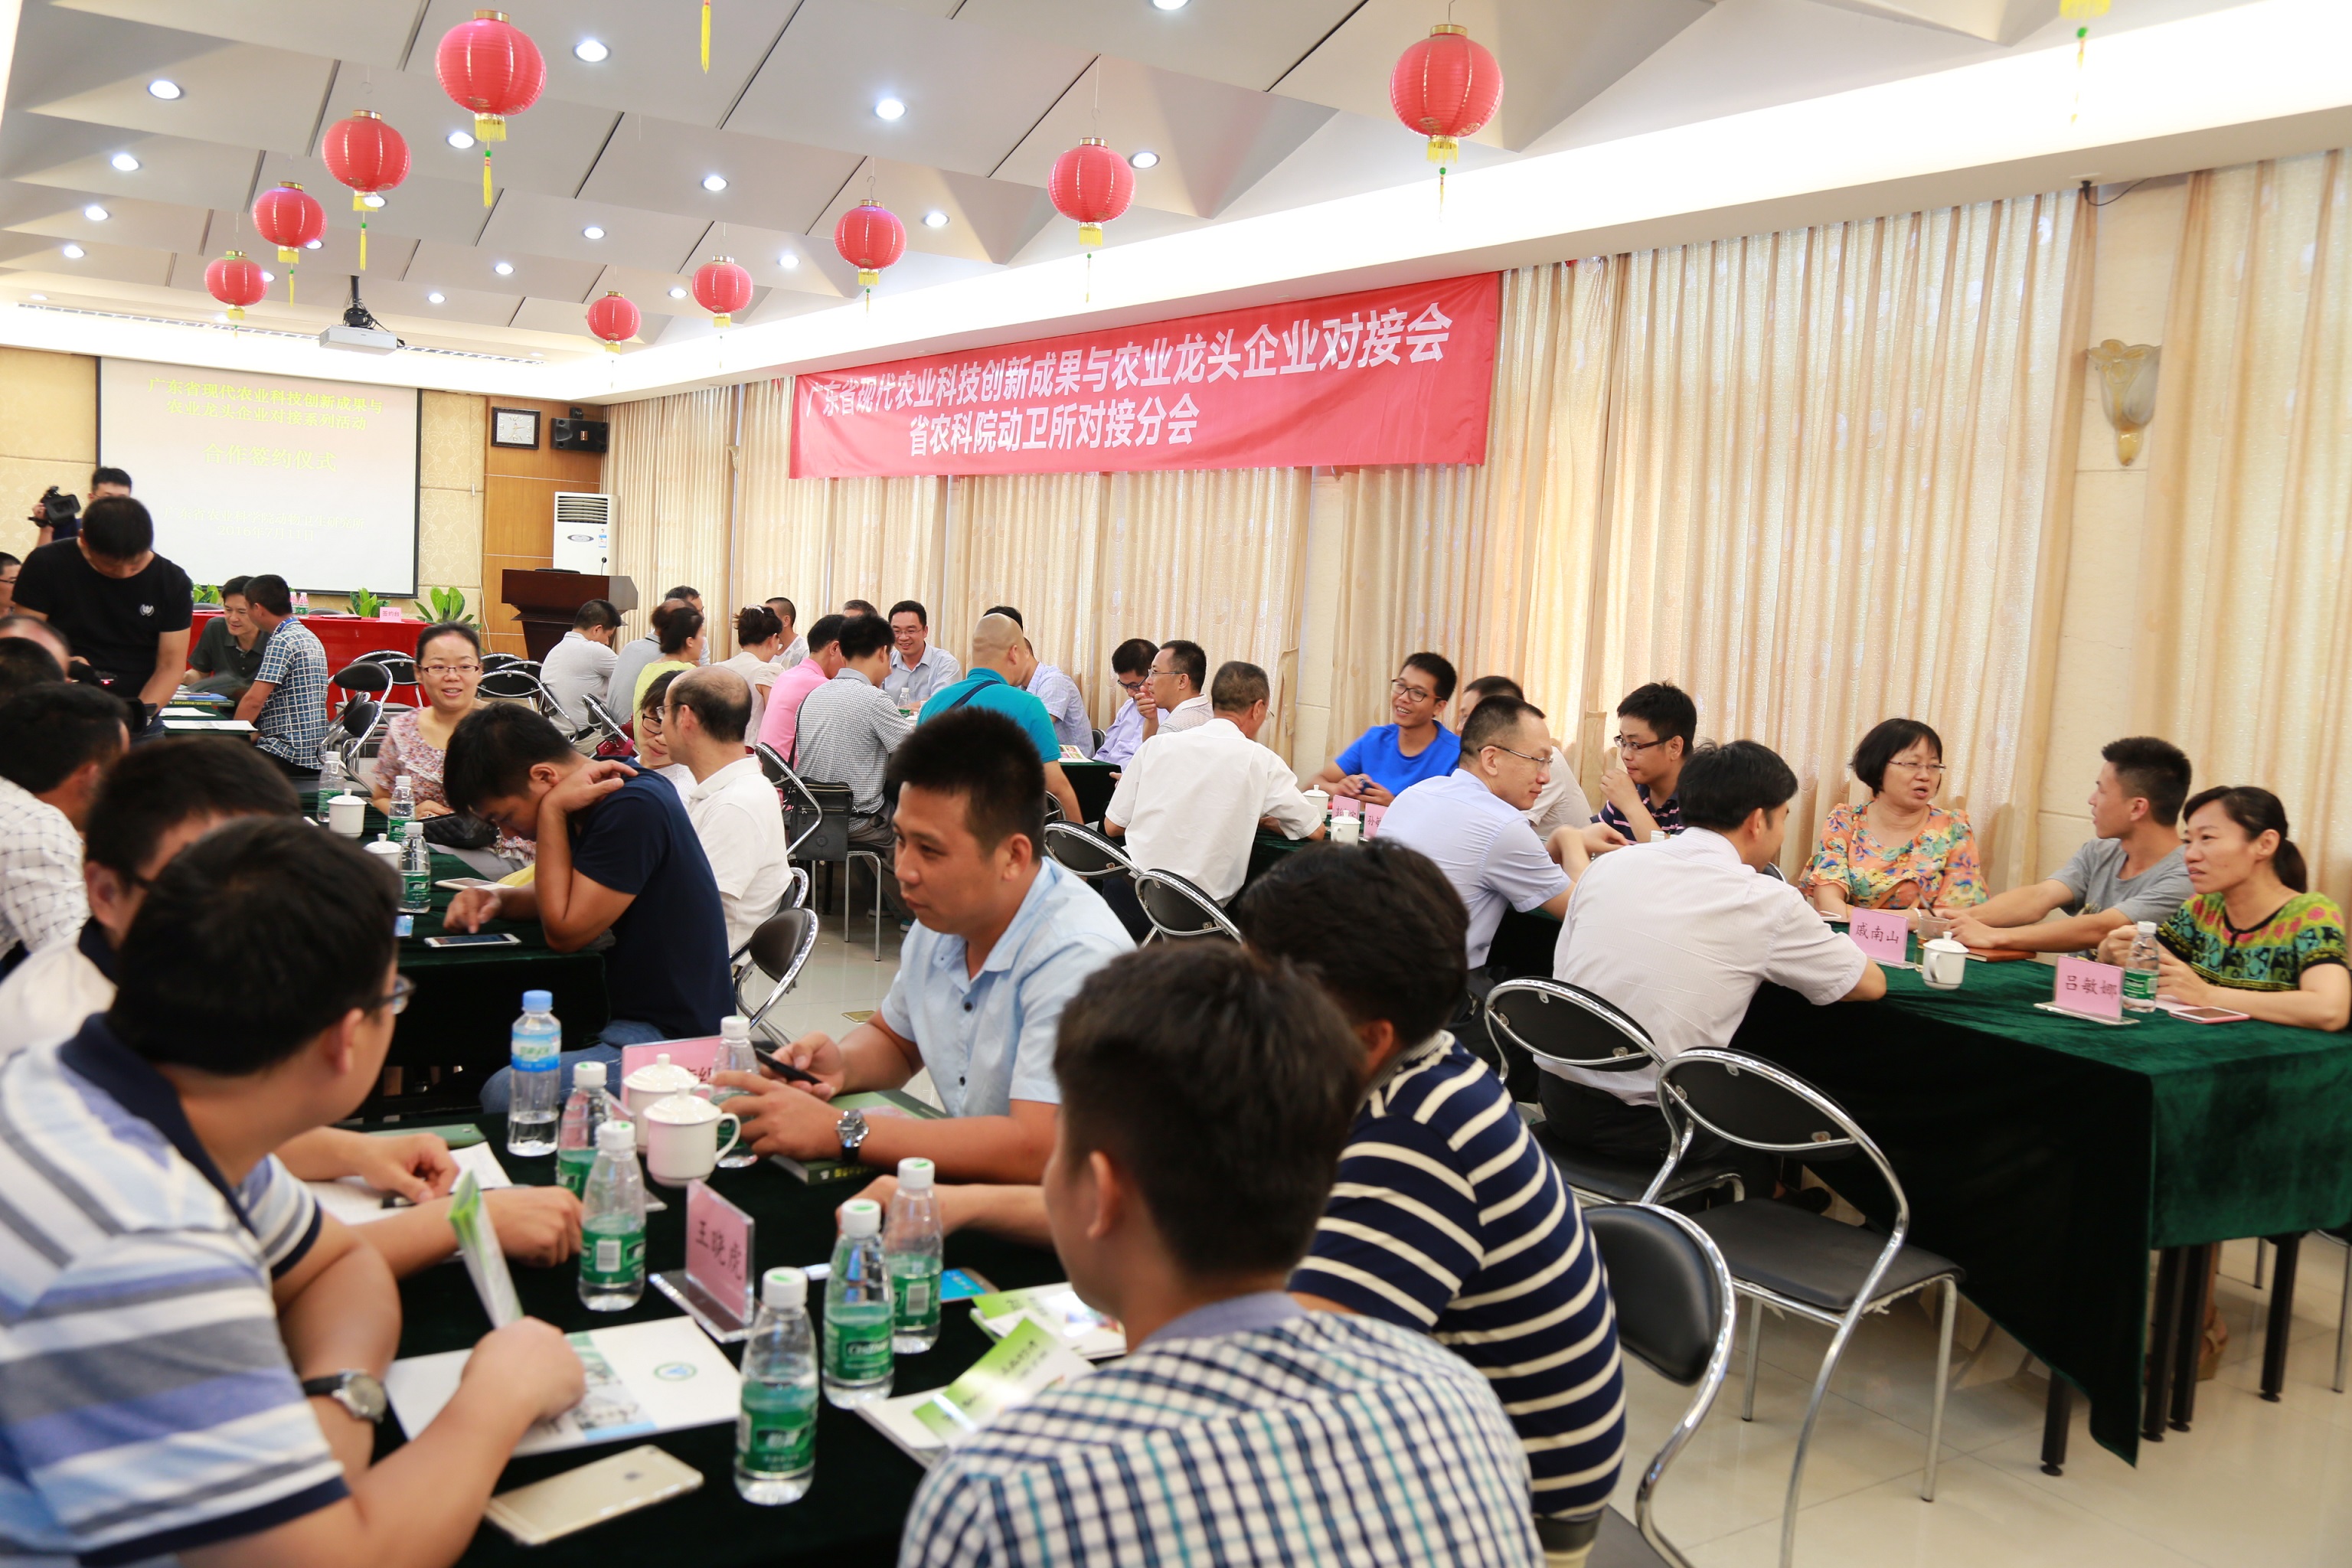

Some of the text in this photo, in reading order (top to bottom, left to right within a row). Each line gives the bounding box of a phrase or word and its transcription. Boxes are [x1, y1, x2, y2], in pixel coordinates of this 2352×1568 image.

[806, 302, 1452, 417] 广东省现代农业科技创新成果与农业龙头企业对接会
[148, 377, 383, 414] 广东省现代农业科技创新成果与
[165, 399, 367, 430] 农业龙头企业对接系列活动
[910, 393, 1199, 457] 省农科院动卫所对接分会
[202, 443, 337, 472] 合作签约仪式
[1856, 922, 1899, 944] 戚南山
[2066, 975, 2118, 998] 吕敏娜
